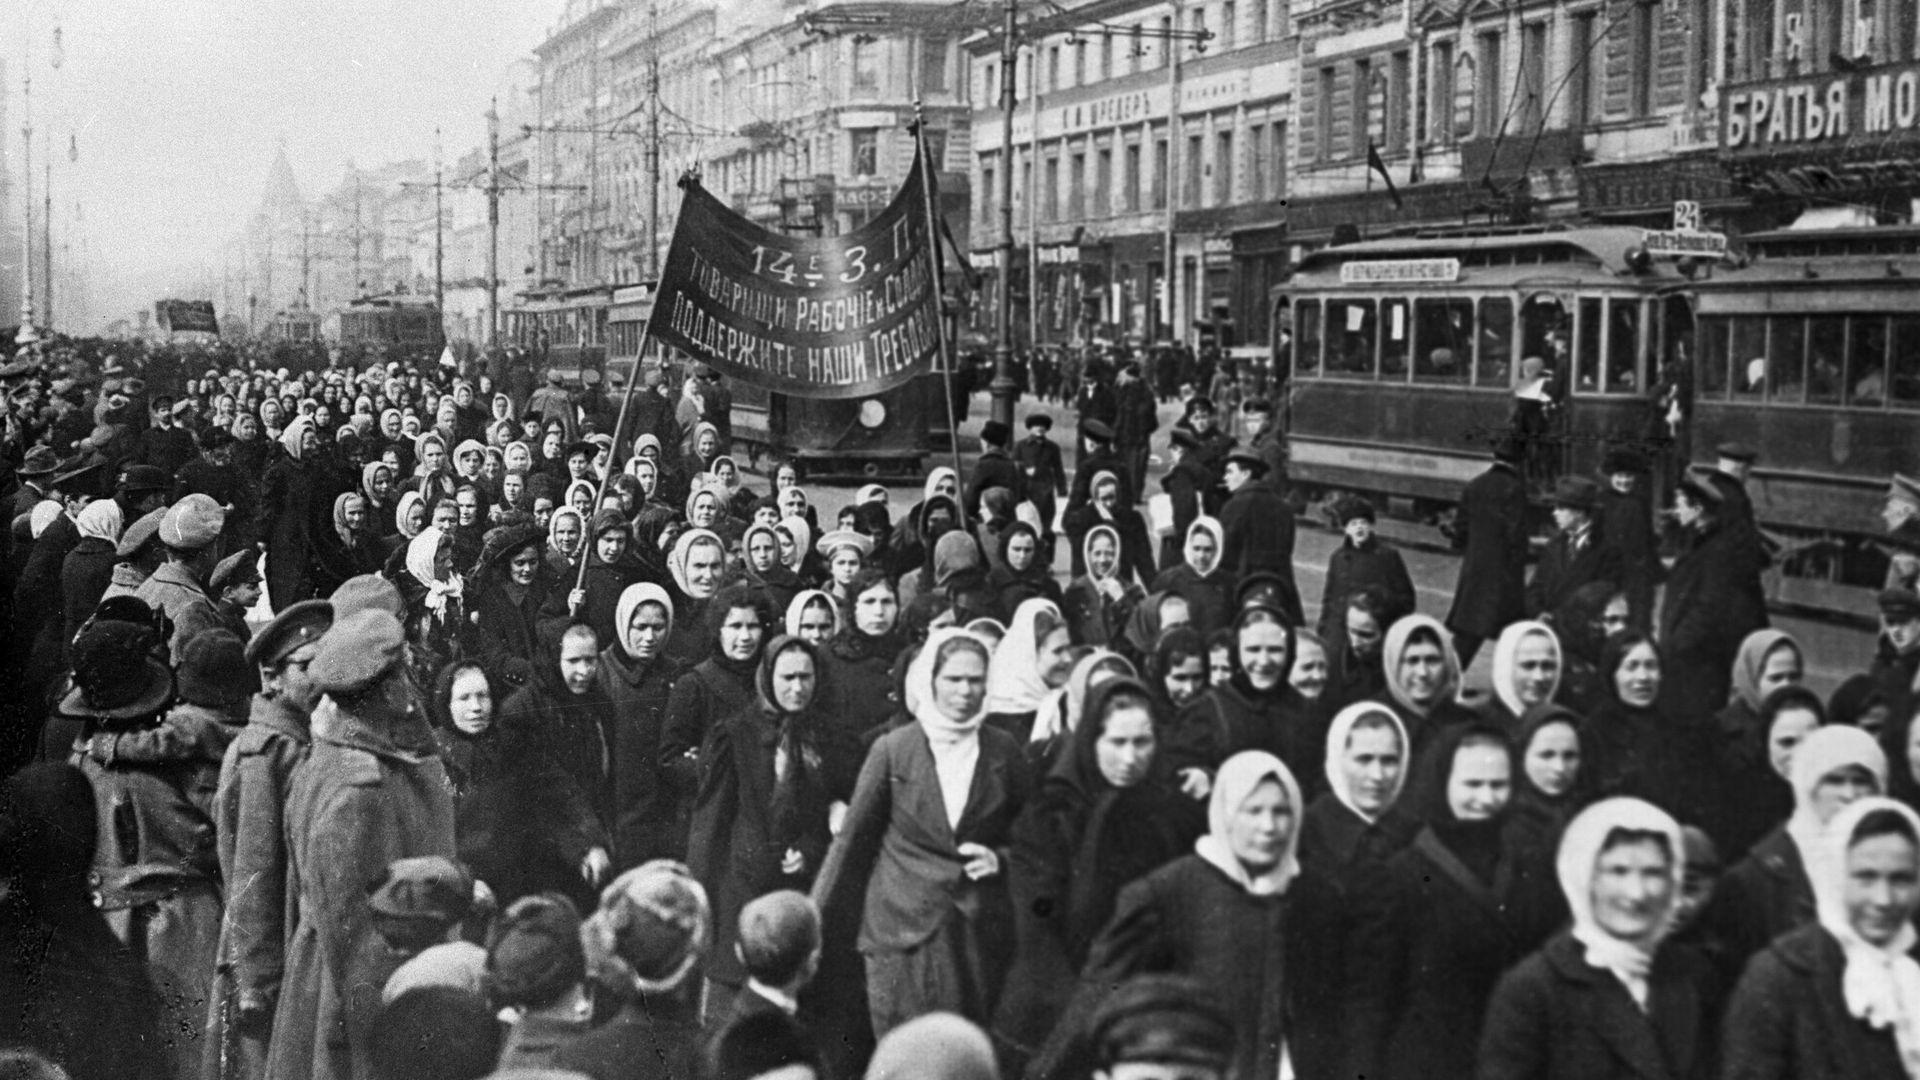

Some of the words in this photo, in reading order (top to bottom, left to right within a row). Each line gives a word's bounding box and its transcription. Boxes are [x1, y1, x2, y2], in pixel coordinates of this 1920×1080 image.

[1726, 80, 1848, 147] БРАТЬЯ
[671, 290, 797, 379] ПОДДЕРЖИТЕ
[808, 340, 867, 385] НАШИ
